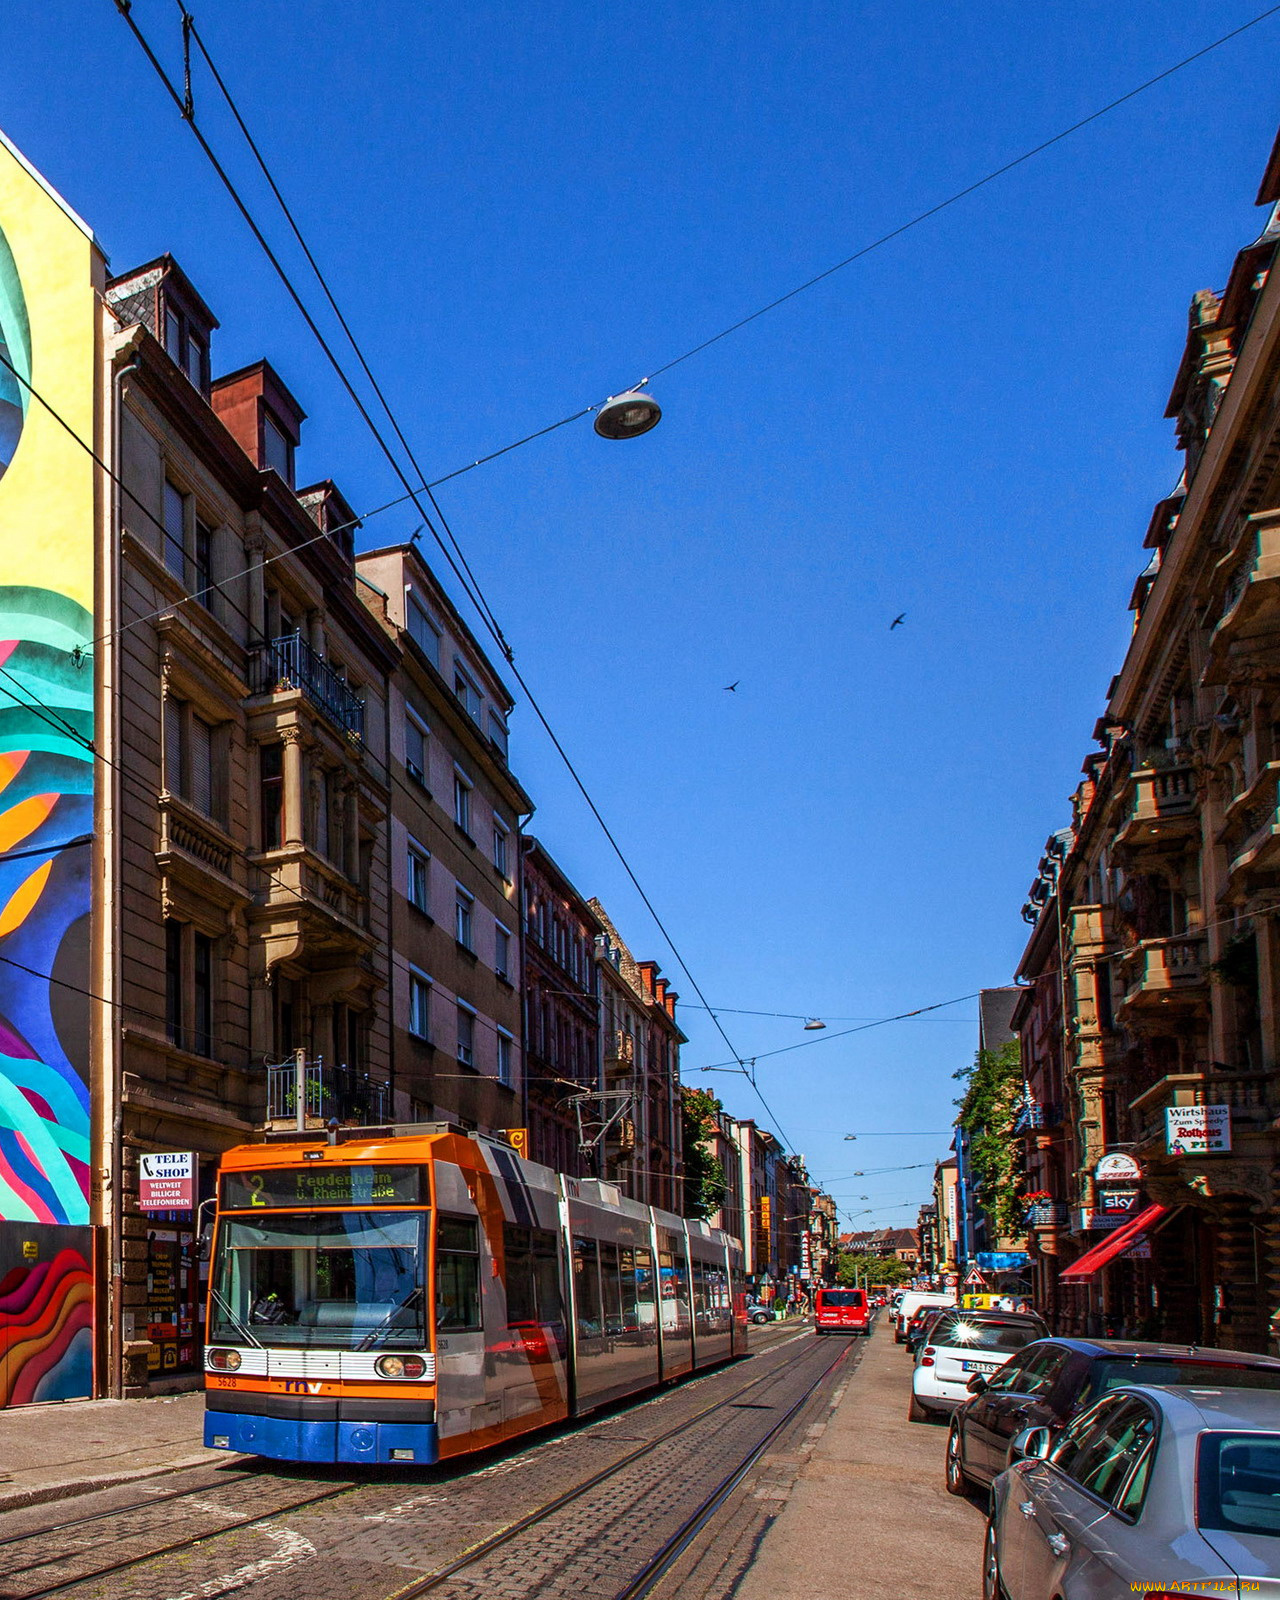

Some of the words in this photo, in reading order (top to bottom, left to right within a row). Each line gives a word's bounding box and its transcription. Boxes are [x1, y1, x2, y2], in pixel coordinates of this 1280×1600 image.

[1169, 1107, 1228, 1117] Wirtshaus
[1190, 1140, 1223, 1149] PILS
[155, 1154, 188, 1164] TELE
[156, 1168, 189, 1178] SHOP
[1101, 1171, 1137, 1179] SPEEDY
[150, 1190, 181, 1198] BILLIGER
[250, 1174, 266, 1207] 2
[296, 1172, 393, 1188] Feudenheim
[313, 1185, 395, 1201] Rheinstraße
[1104, 1195, 1134, 1210] sky
[218, 1377, 237, 1388] 5628
[285, 1379, 323, 1394] rnv
